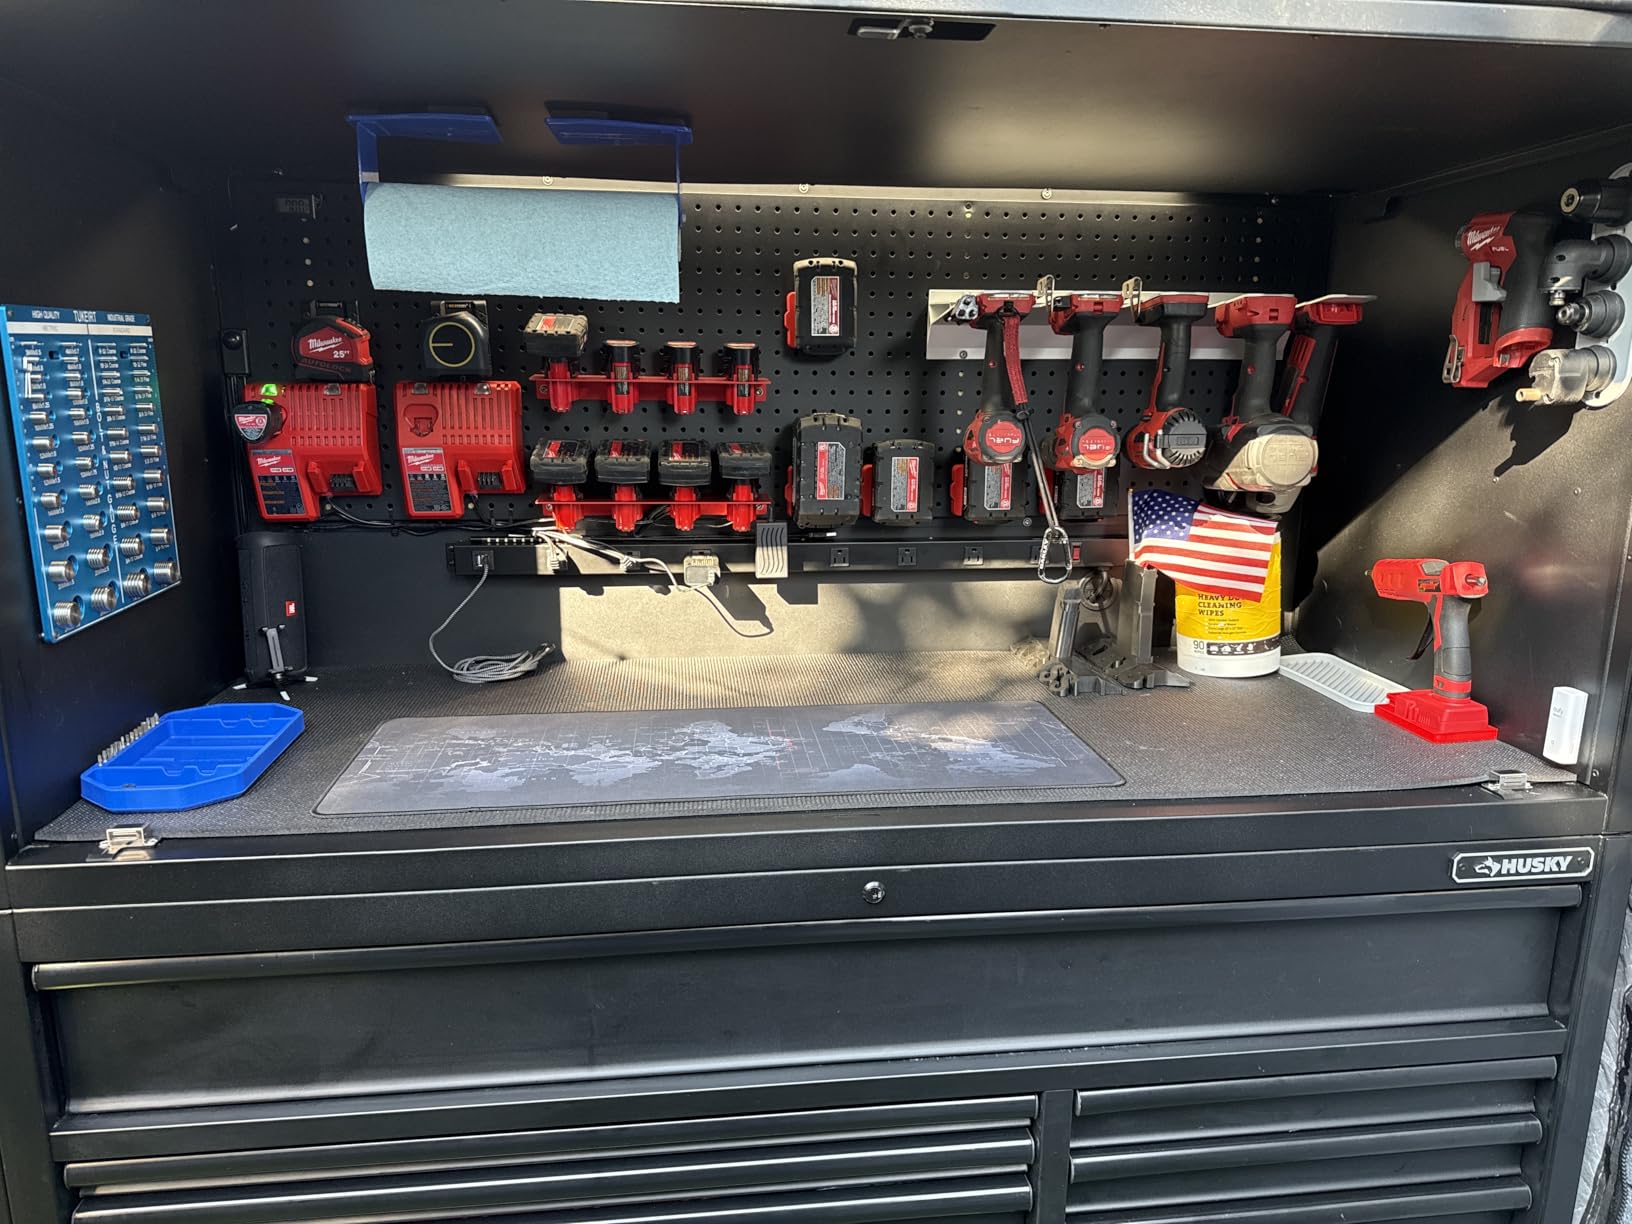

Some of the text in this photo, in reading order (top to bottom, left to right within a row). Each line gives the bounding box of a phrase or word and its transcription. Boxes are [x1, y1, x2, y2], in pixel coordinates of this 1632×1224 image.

[1467, 226, 1501, 246] Milwaukee
[307, 336, 343, 350] Milwaukee
[1197, 601, 1242, 609] CLEANING
[1197, 609, 1225, 617] WIPES
[1193, 640, 1205, 650] 90
[1501, 855, 1573, 875] HUSKY
